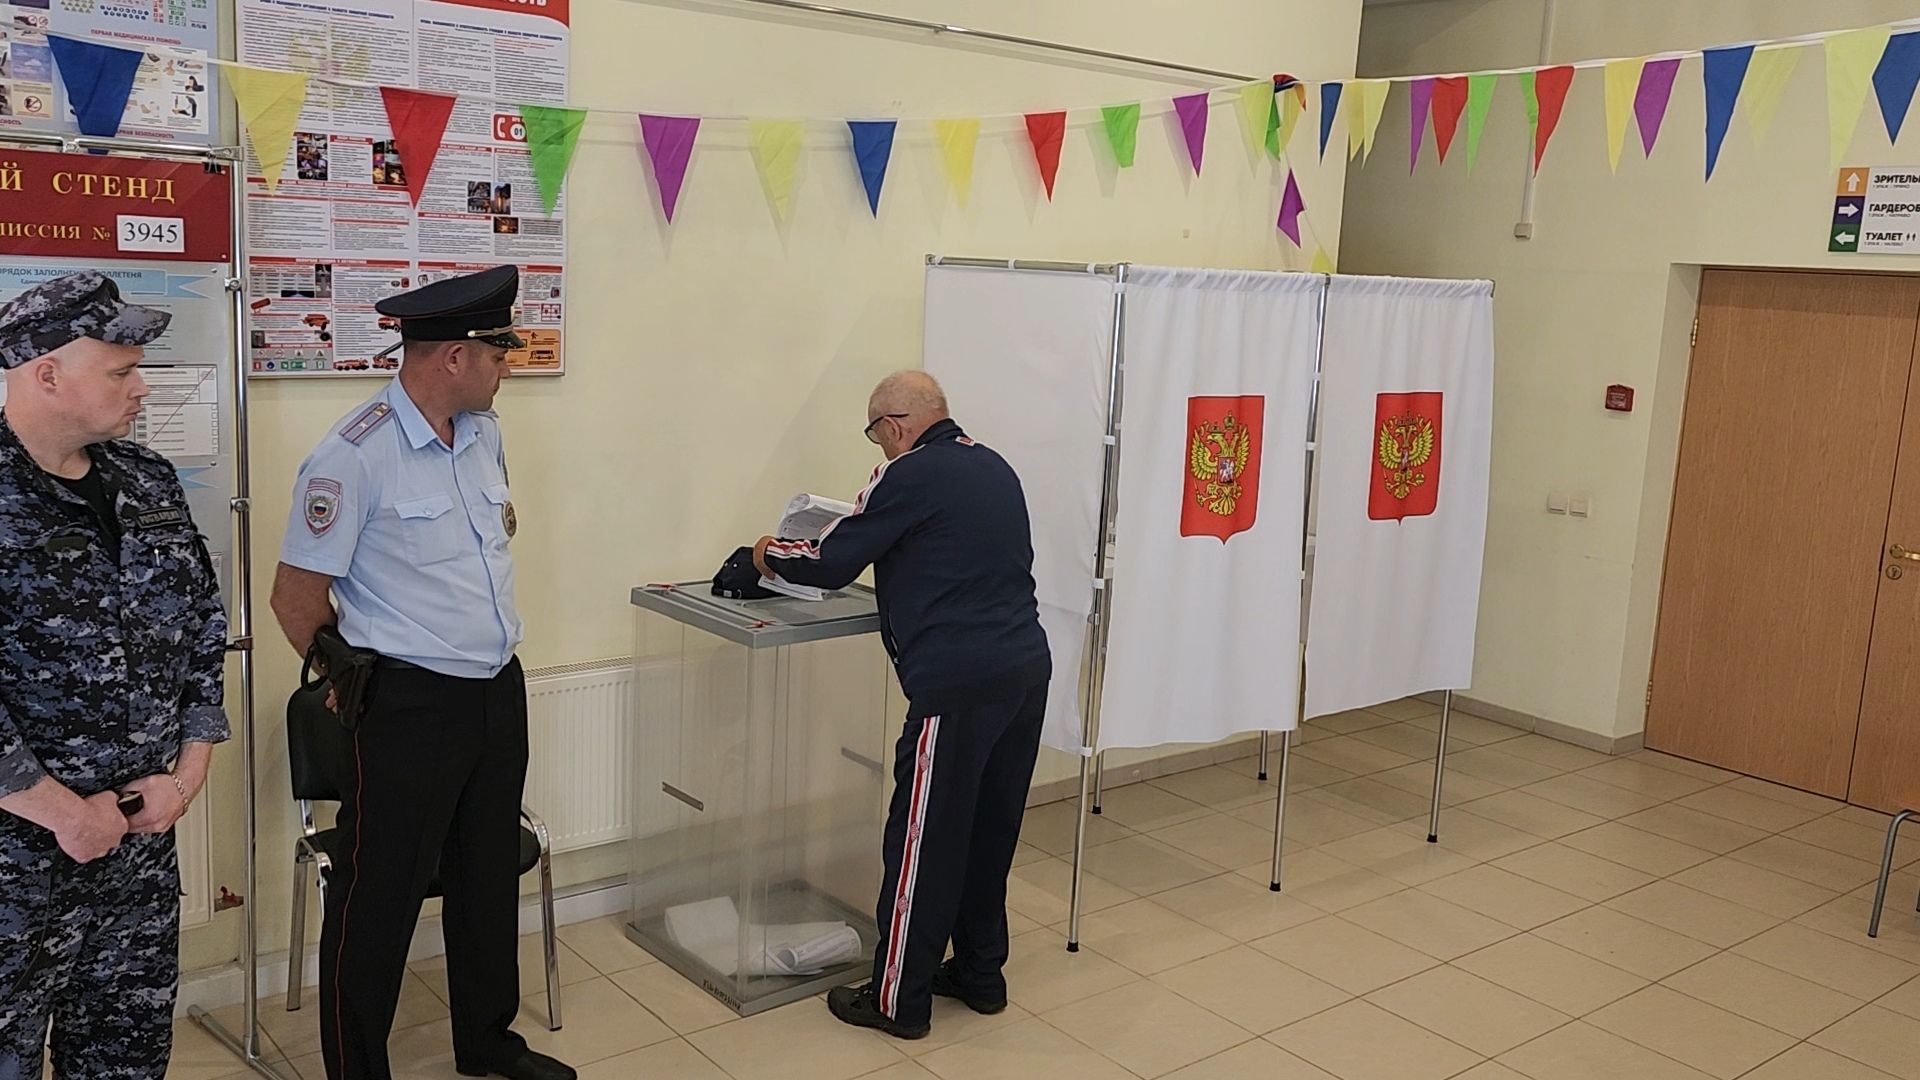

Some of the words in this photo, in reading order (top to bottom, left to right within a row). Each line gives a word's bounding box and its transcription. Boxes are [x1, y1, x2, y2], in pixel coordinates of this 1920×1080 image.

[513, 127, 523, 137] 01
[1873, 174, 1920, 184] ЗРИТЕЛЬ
[52, 171, 175, 205] СТЕНД
[1869, 203, 1920, 213] ГАРДЕРОБ
[92, 226, 111, 241] №
[124, 222, 178, 244] 3945
[1865, 232, 1904, 241] ТУАЛЕТ
